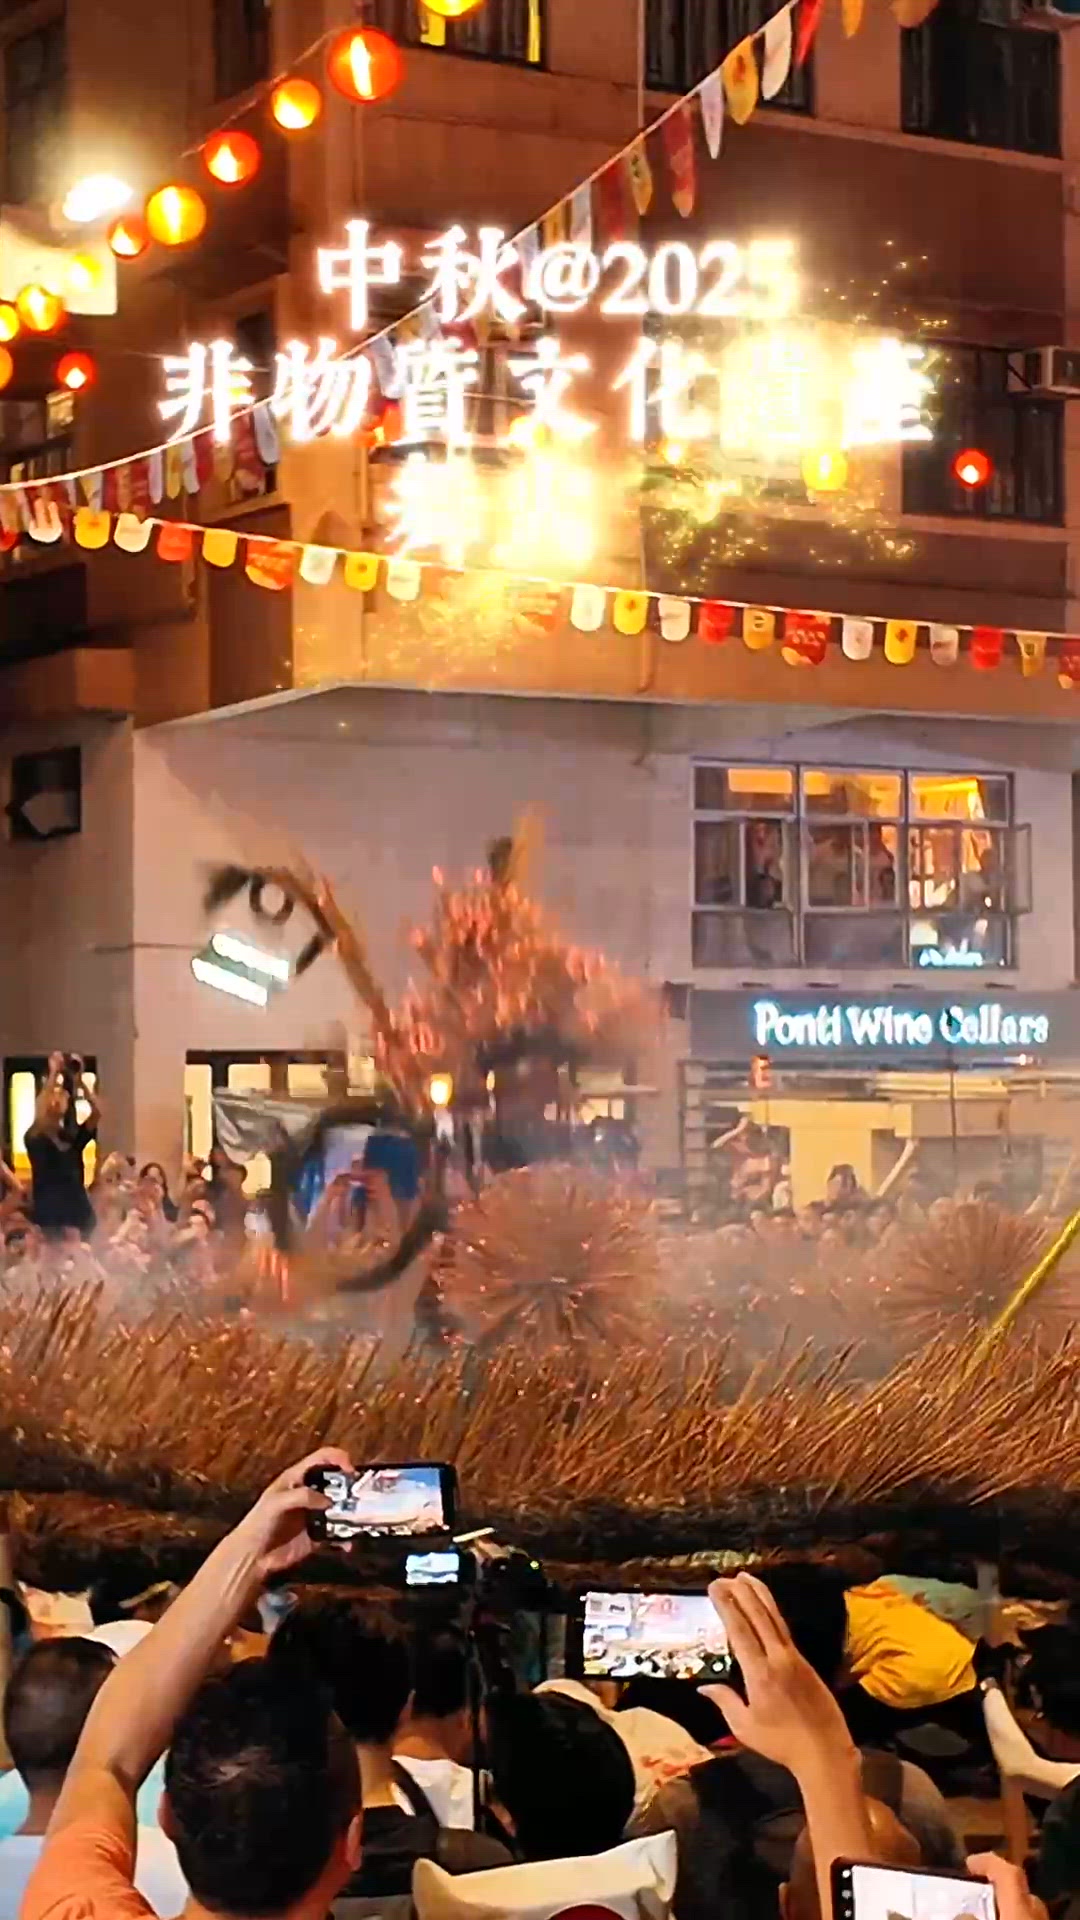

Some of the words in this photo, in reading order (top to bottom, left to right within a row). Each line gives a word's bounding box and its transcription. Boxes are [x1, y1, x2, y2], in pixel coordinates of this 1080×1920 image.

[753, 1001, 842, 1046] Ponti
[845, 1005, 934, 1045] Wine
[939, 1003, 1049, 1045] Cellars
